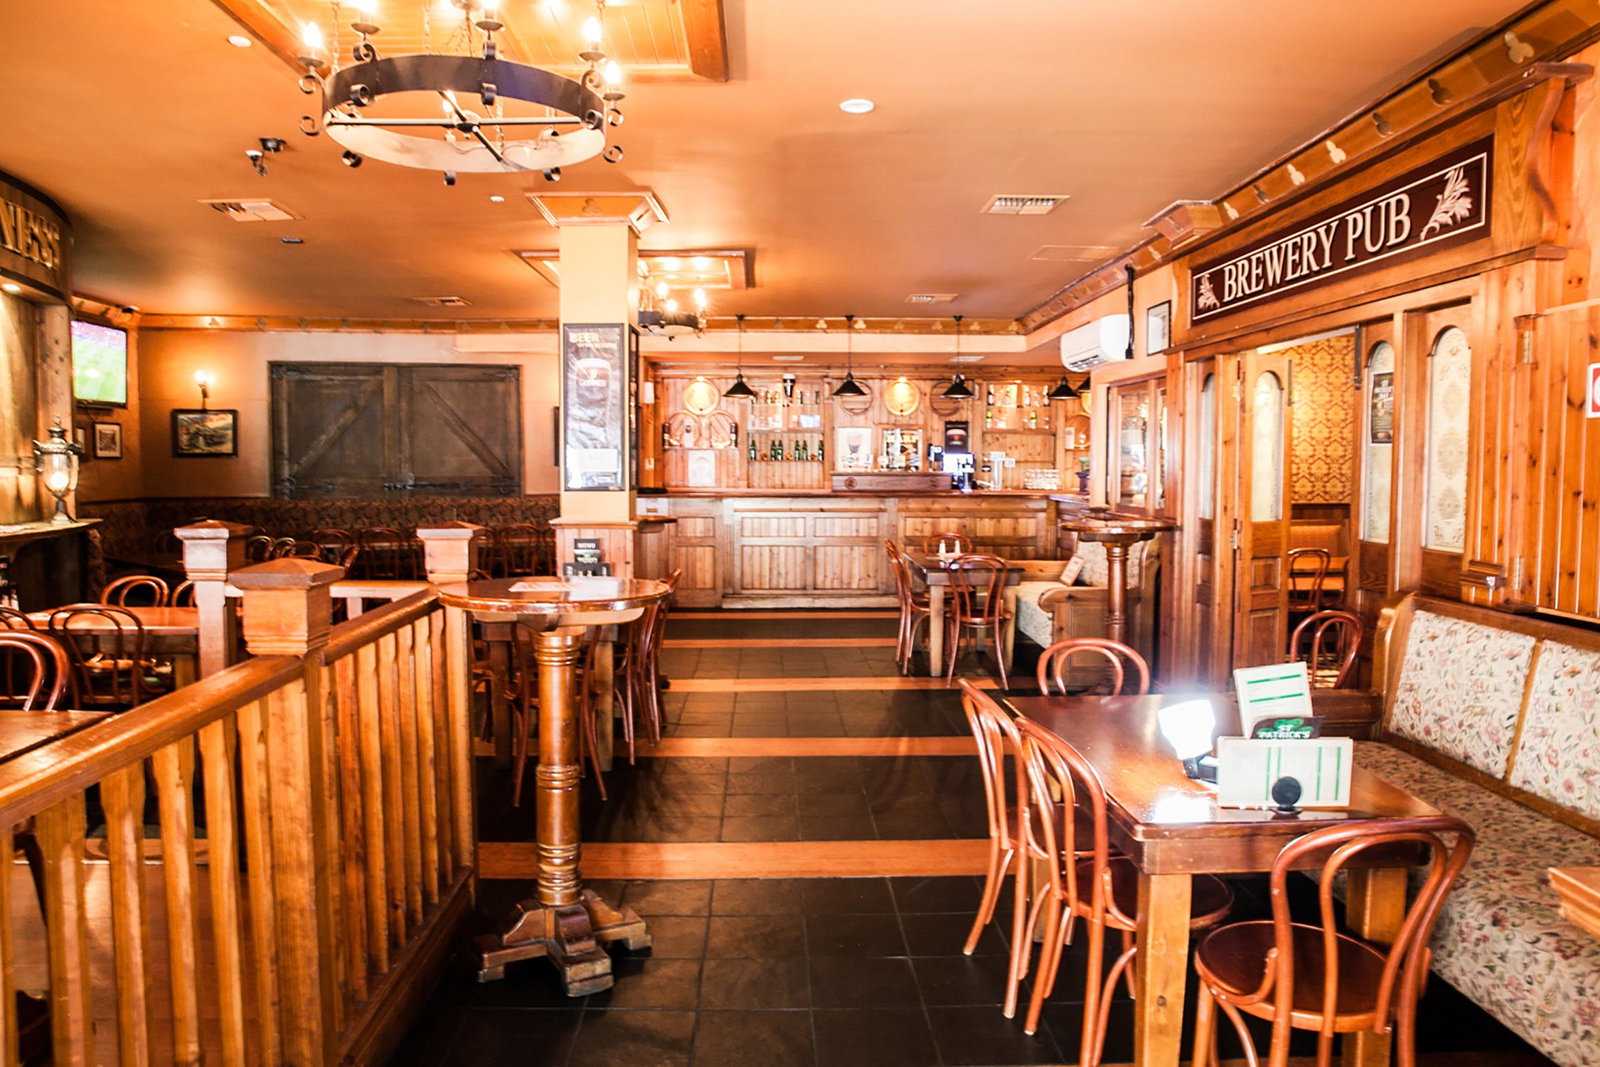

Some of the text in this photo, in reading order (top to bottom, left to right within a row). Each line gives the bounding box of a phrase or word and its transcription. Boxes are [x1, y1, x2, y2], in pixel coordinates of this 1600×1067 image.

[1223, 193, 1412, 302] BREWERY PUB
[569, 332, 600, 344] BEER
